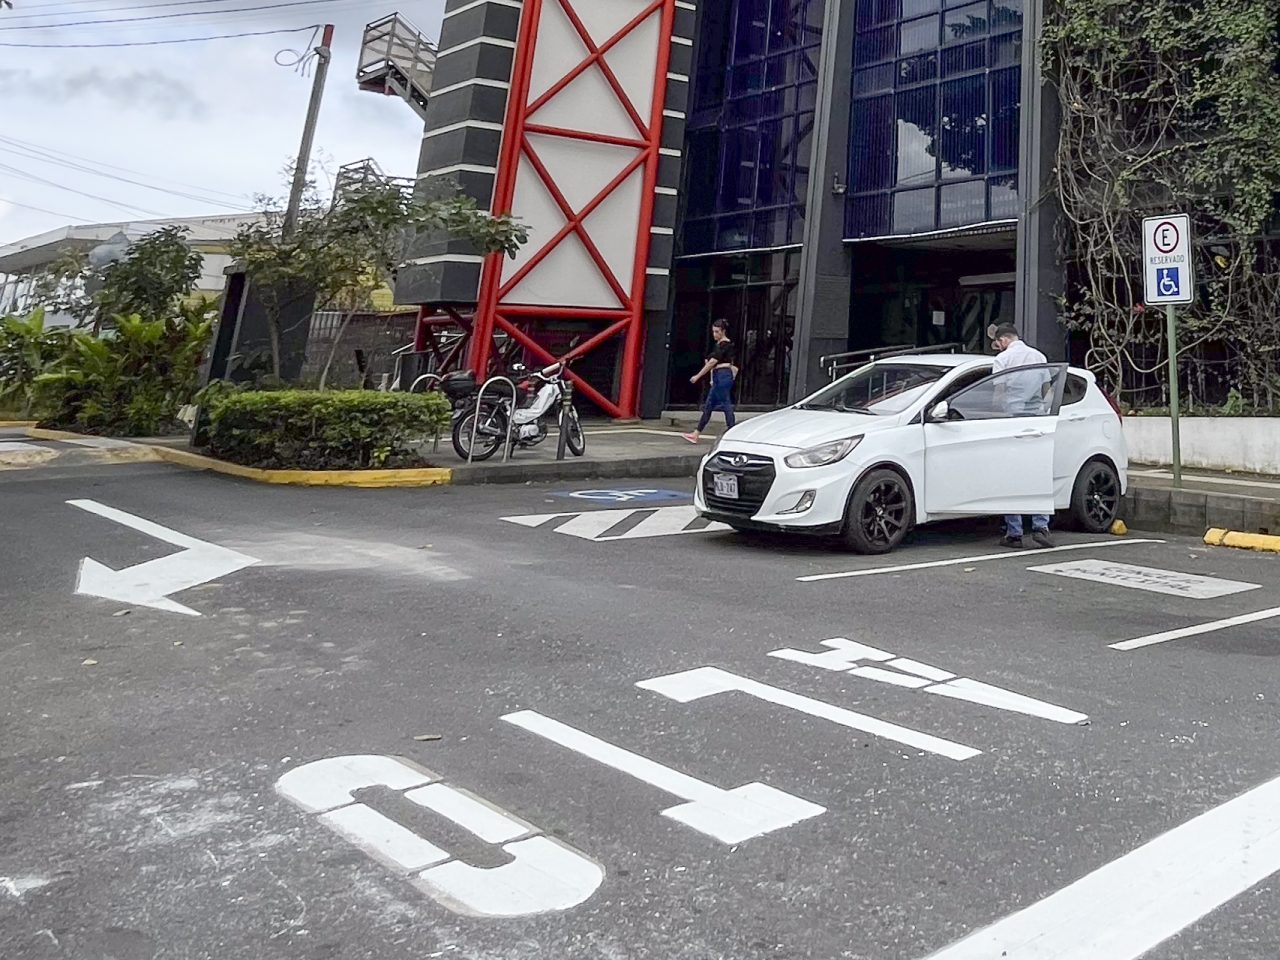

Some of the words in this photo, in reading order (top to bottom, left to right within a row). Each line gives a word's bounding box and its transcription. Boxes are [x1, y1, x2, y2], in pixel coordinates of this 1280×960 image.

[1162, 228, 1171, 247] E
[1150, 254, 1185, 265] RESERVADO
[274, 638, 1088, 918] ALTO
